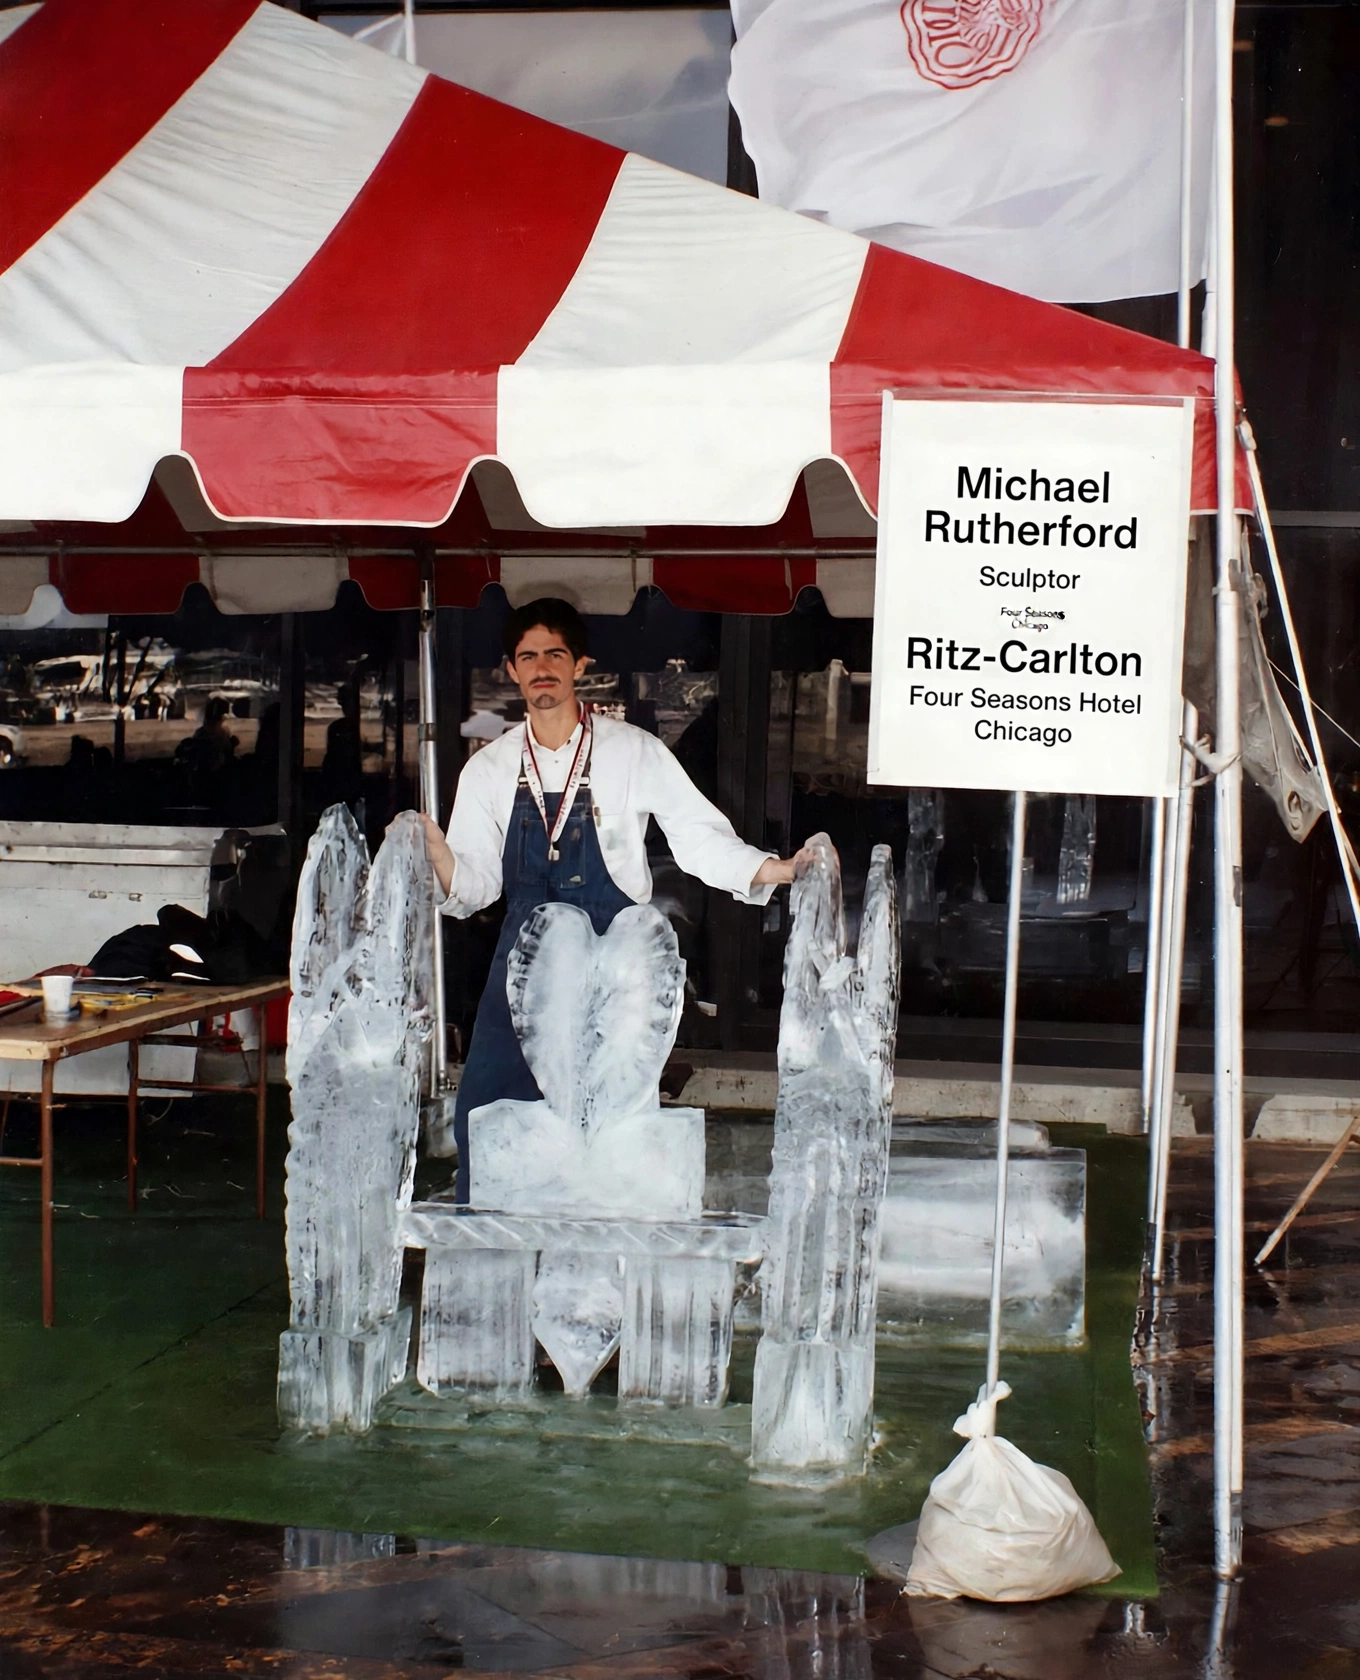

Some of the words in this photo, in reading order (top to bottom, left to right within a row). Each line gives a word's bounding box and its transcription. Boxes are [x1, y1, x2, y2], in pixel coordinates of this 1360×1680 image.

[957, 465, 1110, 504] Michael
[925, 509, 1138, 550] Rutherford
[979, 565, 1081, 593] Sculptor
[907, 636, 1142, 677] Ritz-Carlton
[909, 685, 964, 707] Four
[970, 687, 1071, 712] Seasons
[1079, 691, 1142, 715] Hotel
[974, 719, 1072, 747] Chicago
